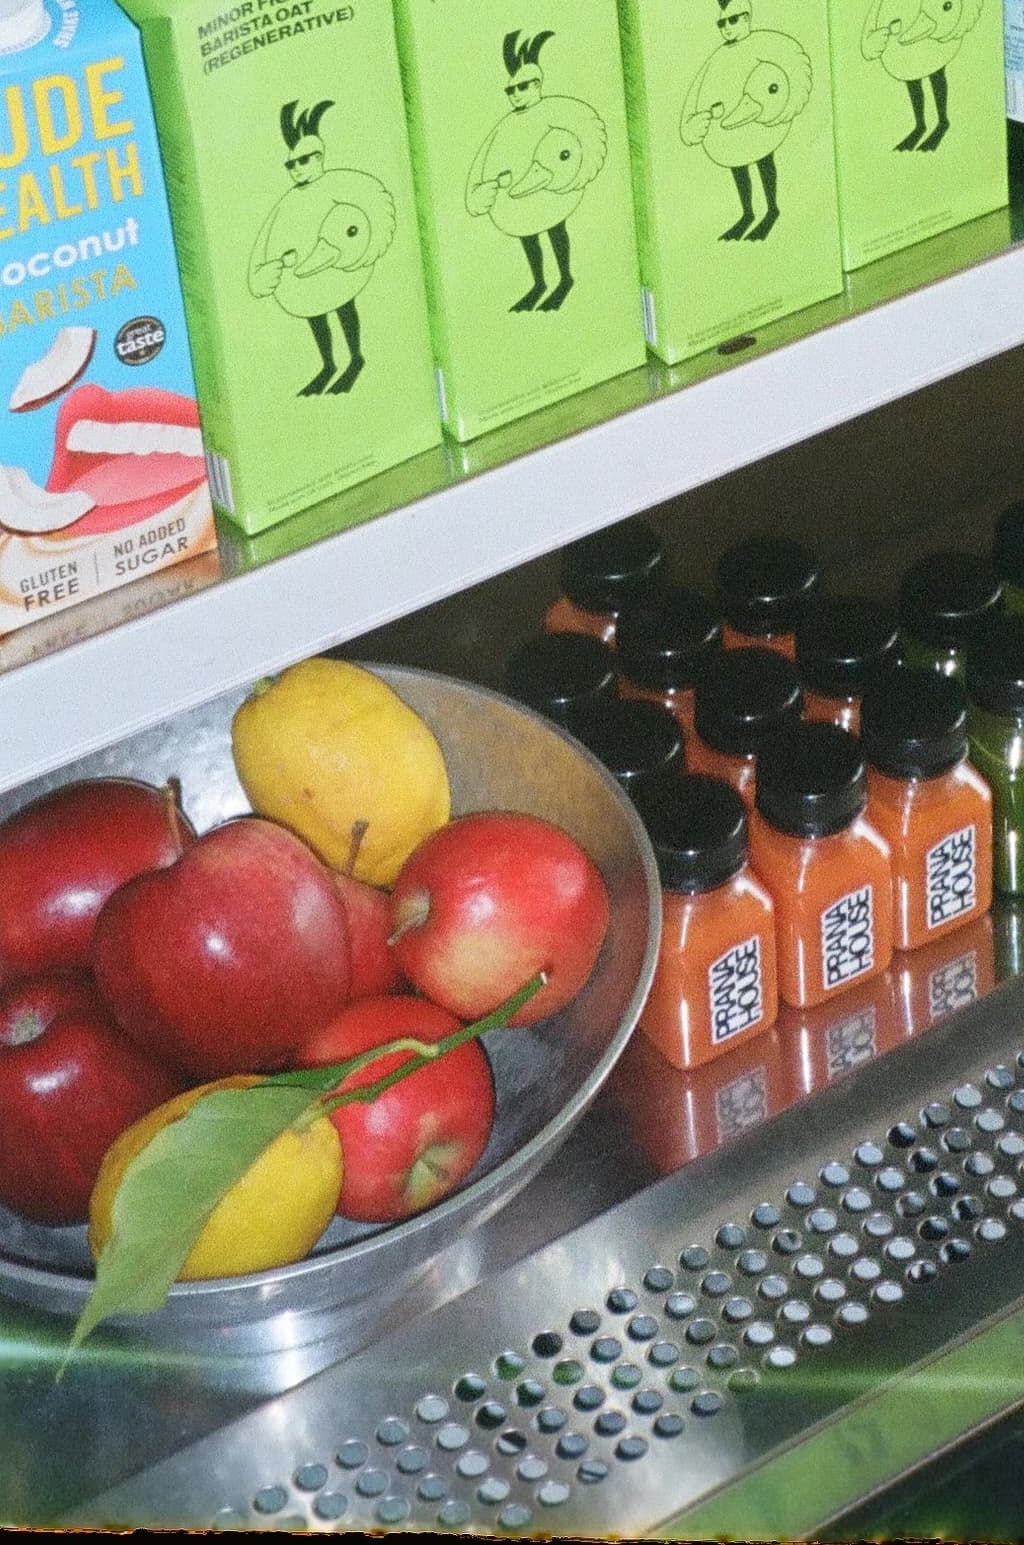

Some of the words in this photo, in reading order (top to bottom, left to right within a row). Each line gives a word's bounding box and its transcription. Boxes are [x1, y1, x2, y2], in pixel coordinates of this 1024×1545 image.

[196, 2, 254, 40] MINOR
[200, 13, 275, 58] BARISTA
[275, 0, 314, 26] OAT
[202, 5, 356, 77] (REGENERATIVE)
[116, 329, 165, 356] taste
[113, 537, 136, 558] NO
[138, 517, 188, 549] ADDED
[115, 535, 190, 577] SUGAR
[19, 560, 79, 594] GLUTEN
[23, 579, 81, 612] FREE
[929, 837, 952, 926] PRANA
[951, 827, 974, 915] HOUSE
[823, 896, 850, 986] PRANA
[847, 888, 873, 975] HOUSE
[711, 950, 740, 1042] PRANA
[735, 938, 763, 1029] HOUSE
